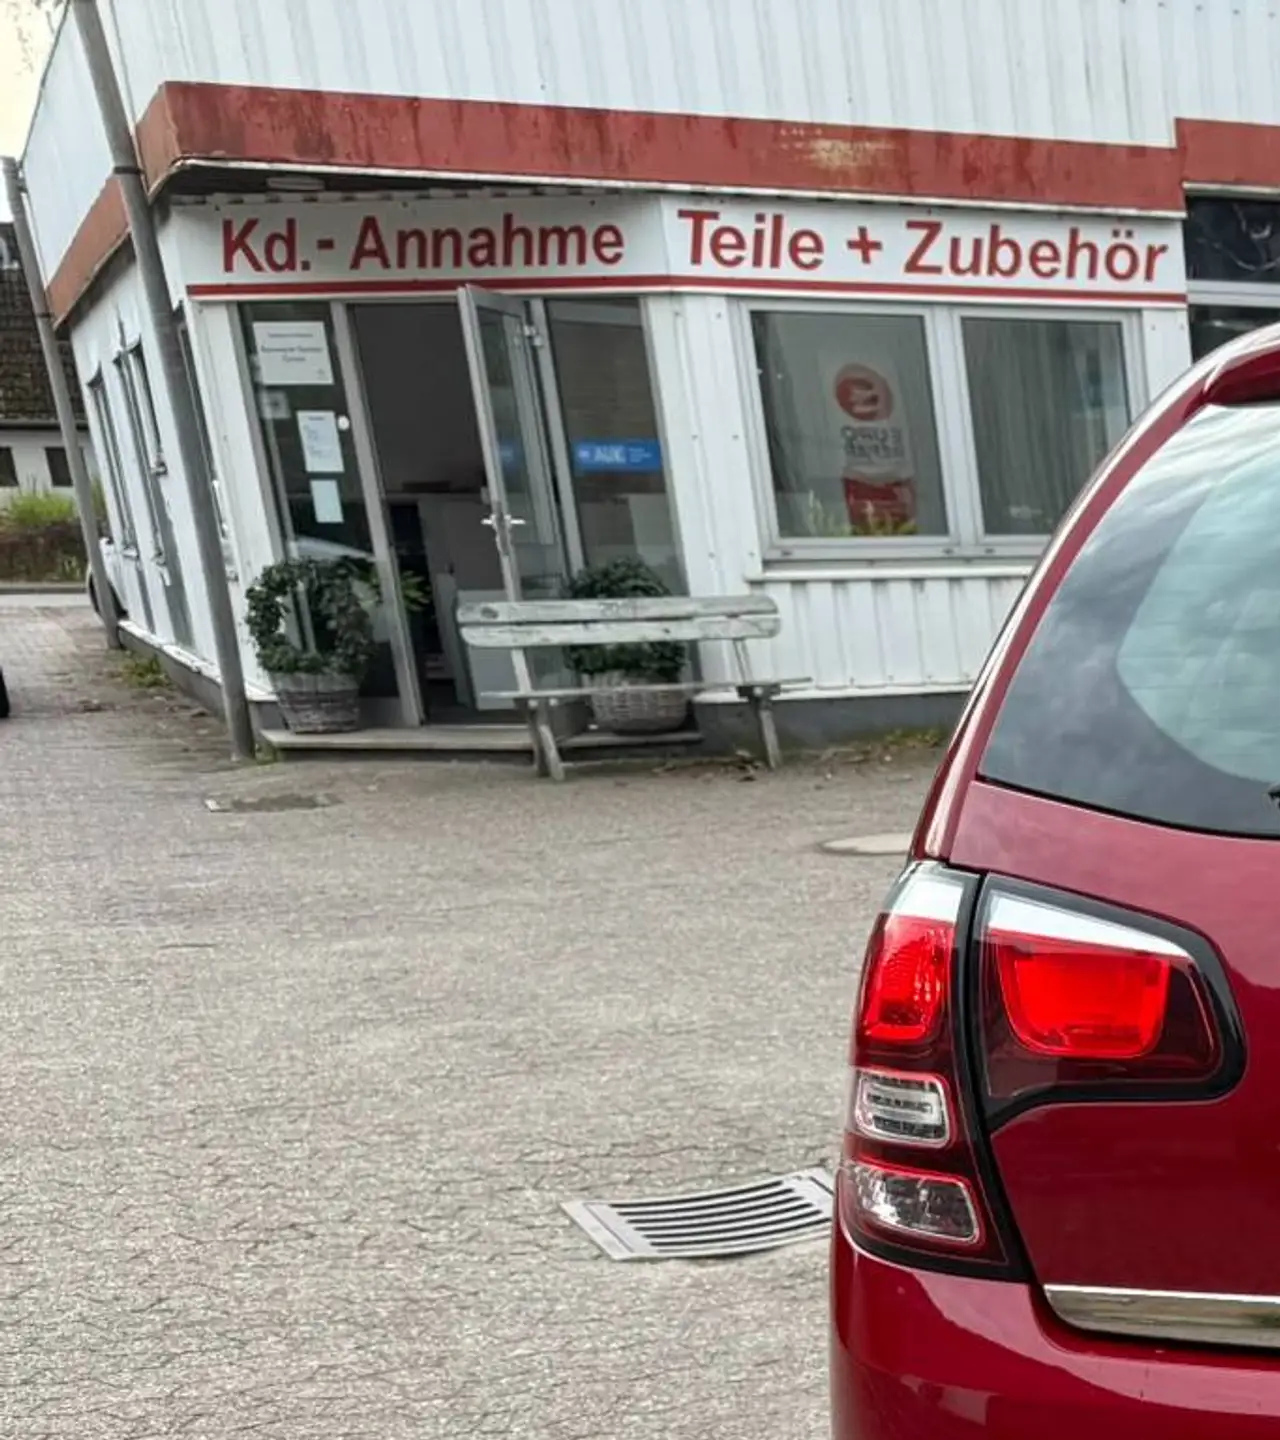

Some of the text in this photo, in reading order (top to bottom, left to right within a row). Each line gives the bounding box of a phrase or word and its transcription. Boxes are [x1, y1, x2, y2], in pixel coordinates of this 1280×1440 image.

[678, 209, 1169, 281] Teile + Zubehör
